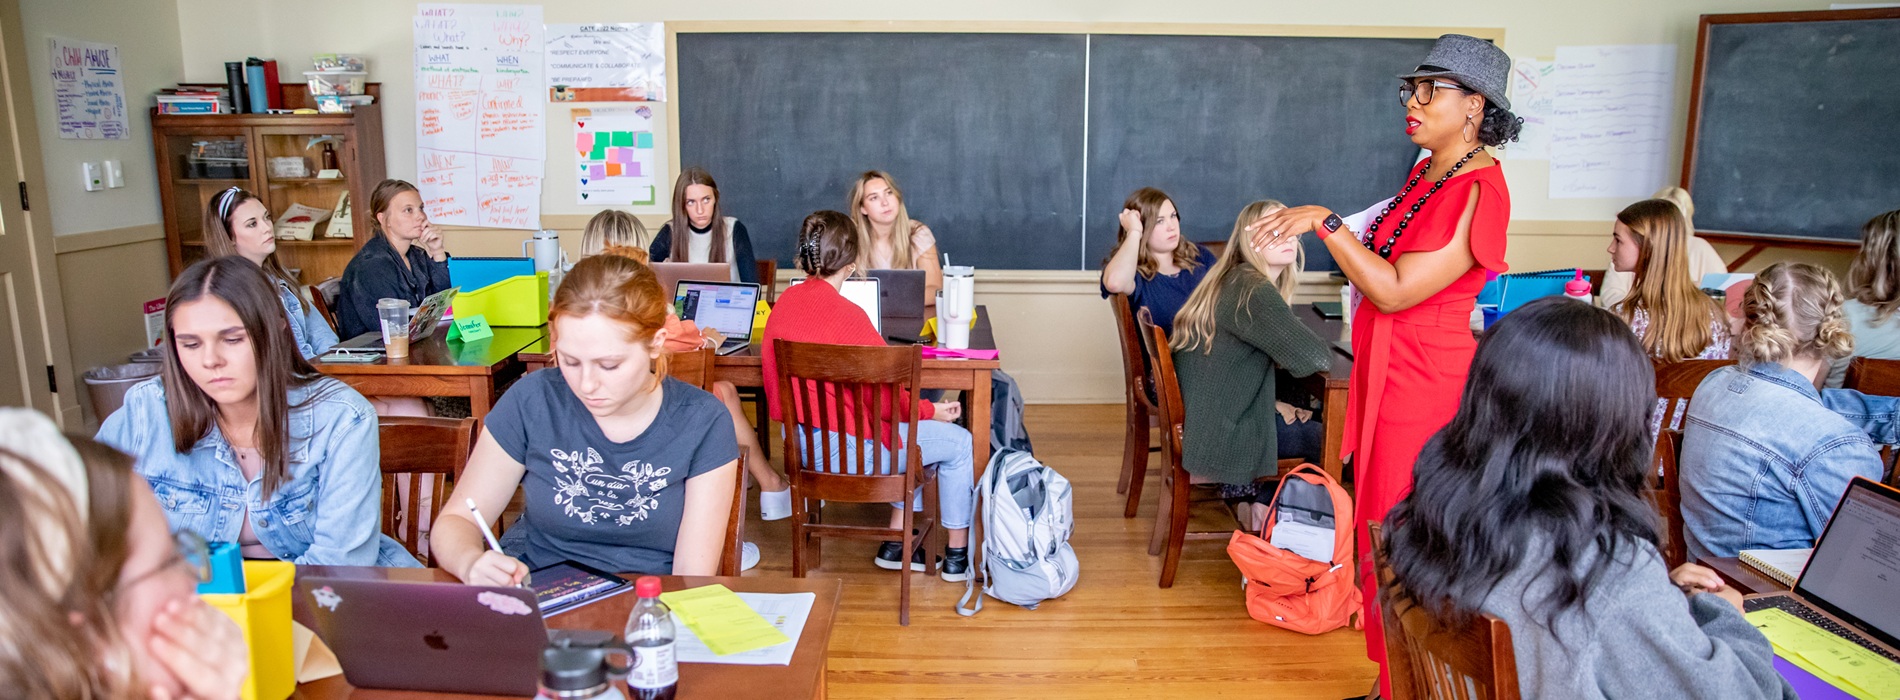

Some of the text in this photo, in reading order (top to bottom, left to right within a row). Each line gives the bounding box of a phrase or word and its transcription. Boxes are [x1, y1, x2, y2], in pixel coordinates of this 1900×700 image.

[433, 31, 466, 44] What?
[499, 33, 530, 49] Why?
[428, 54, 449, 62] WHAT
[496, 56, 518, 64] WHEN
[428, 74, 465, 88] WHAT?
[606, 490, 618, 499] la
[598, 499, 616, 507] vez
